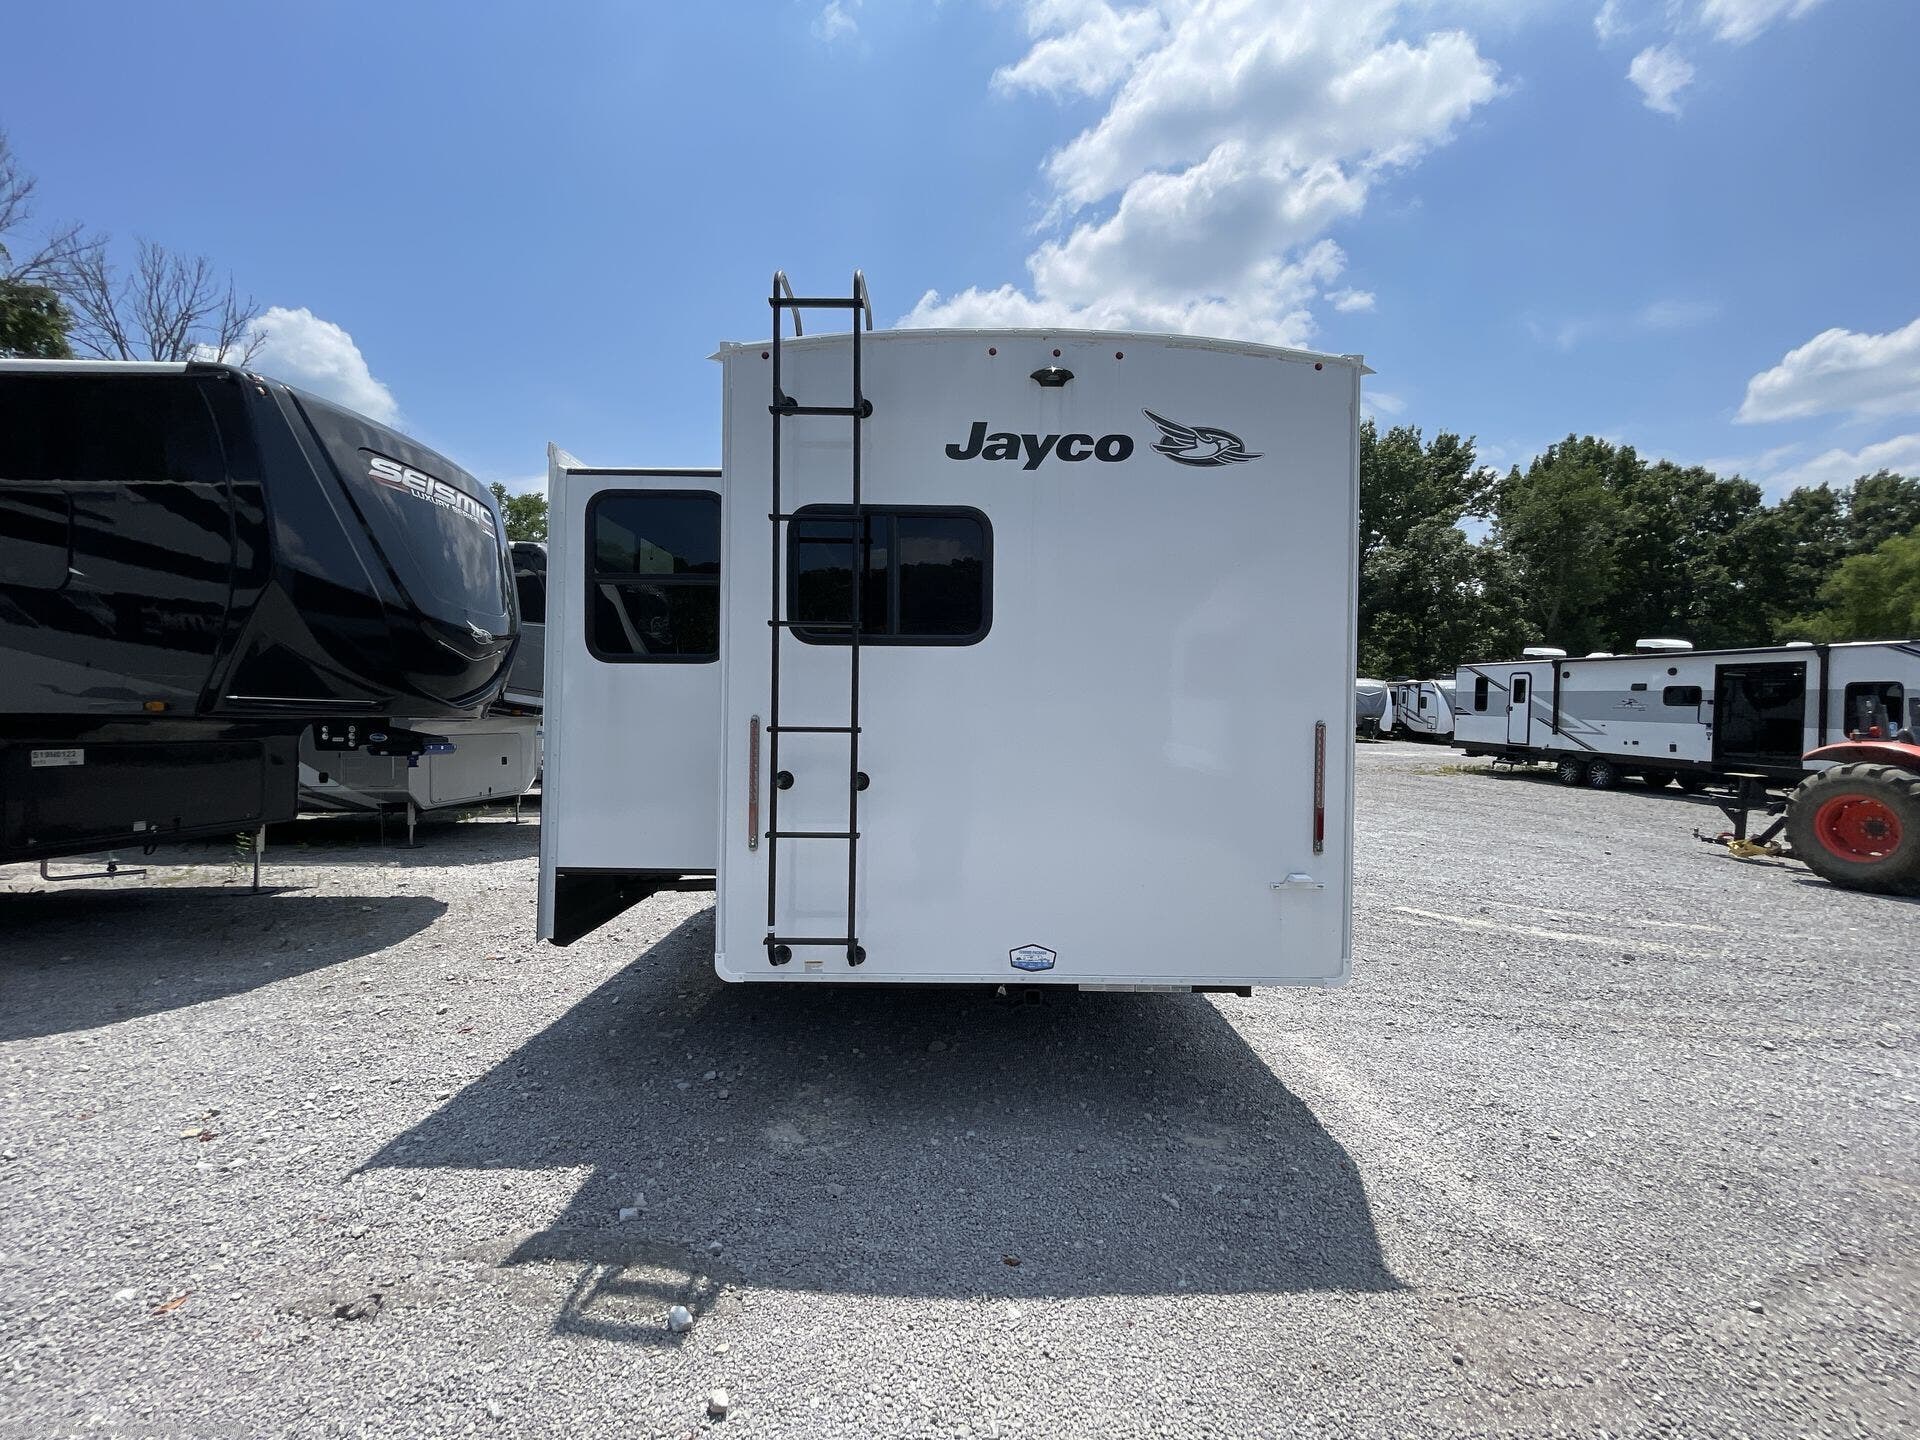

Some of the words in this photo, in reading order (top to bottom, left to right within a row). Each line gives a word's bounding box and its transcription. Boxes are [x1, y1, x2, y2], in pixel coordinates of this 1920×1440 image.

[945, 421, 1134, 471] Jayco
[368, 457, 494, 526] SEISMIC
[411, 489, 450, 510] LUXURY
